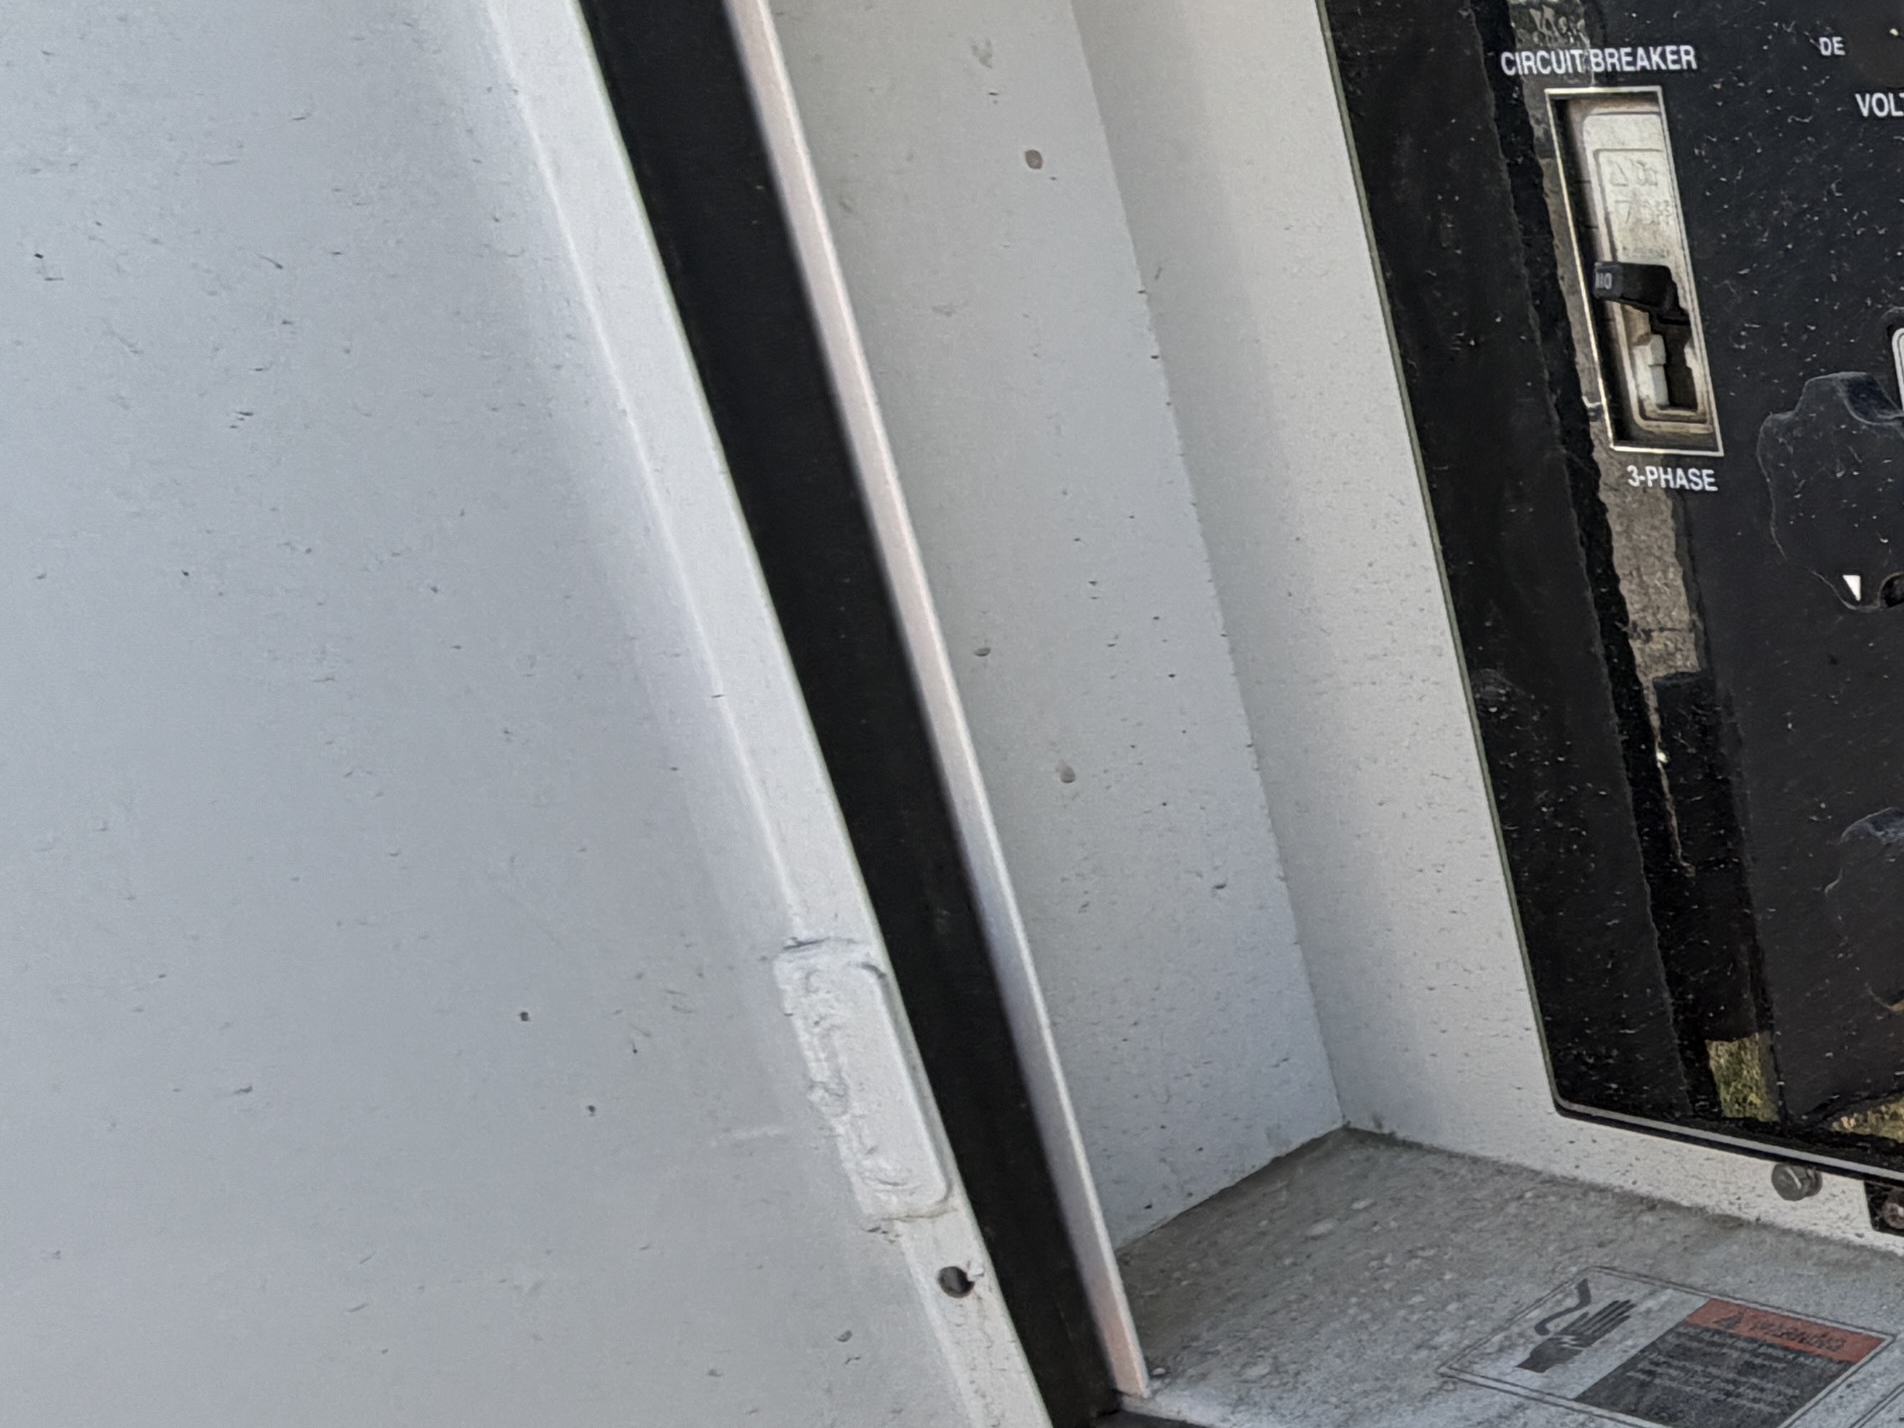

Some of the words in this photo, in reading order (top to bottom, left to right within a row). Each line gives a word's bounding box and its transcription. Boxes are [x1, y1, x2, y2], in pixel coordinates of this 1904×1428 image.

[1501, 50, 1583, 76] CIRCUIT
[1589, 45, 1697, 72] BREAKER
[1627, 465, 1719, 491] 3-PHASE
